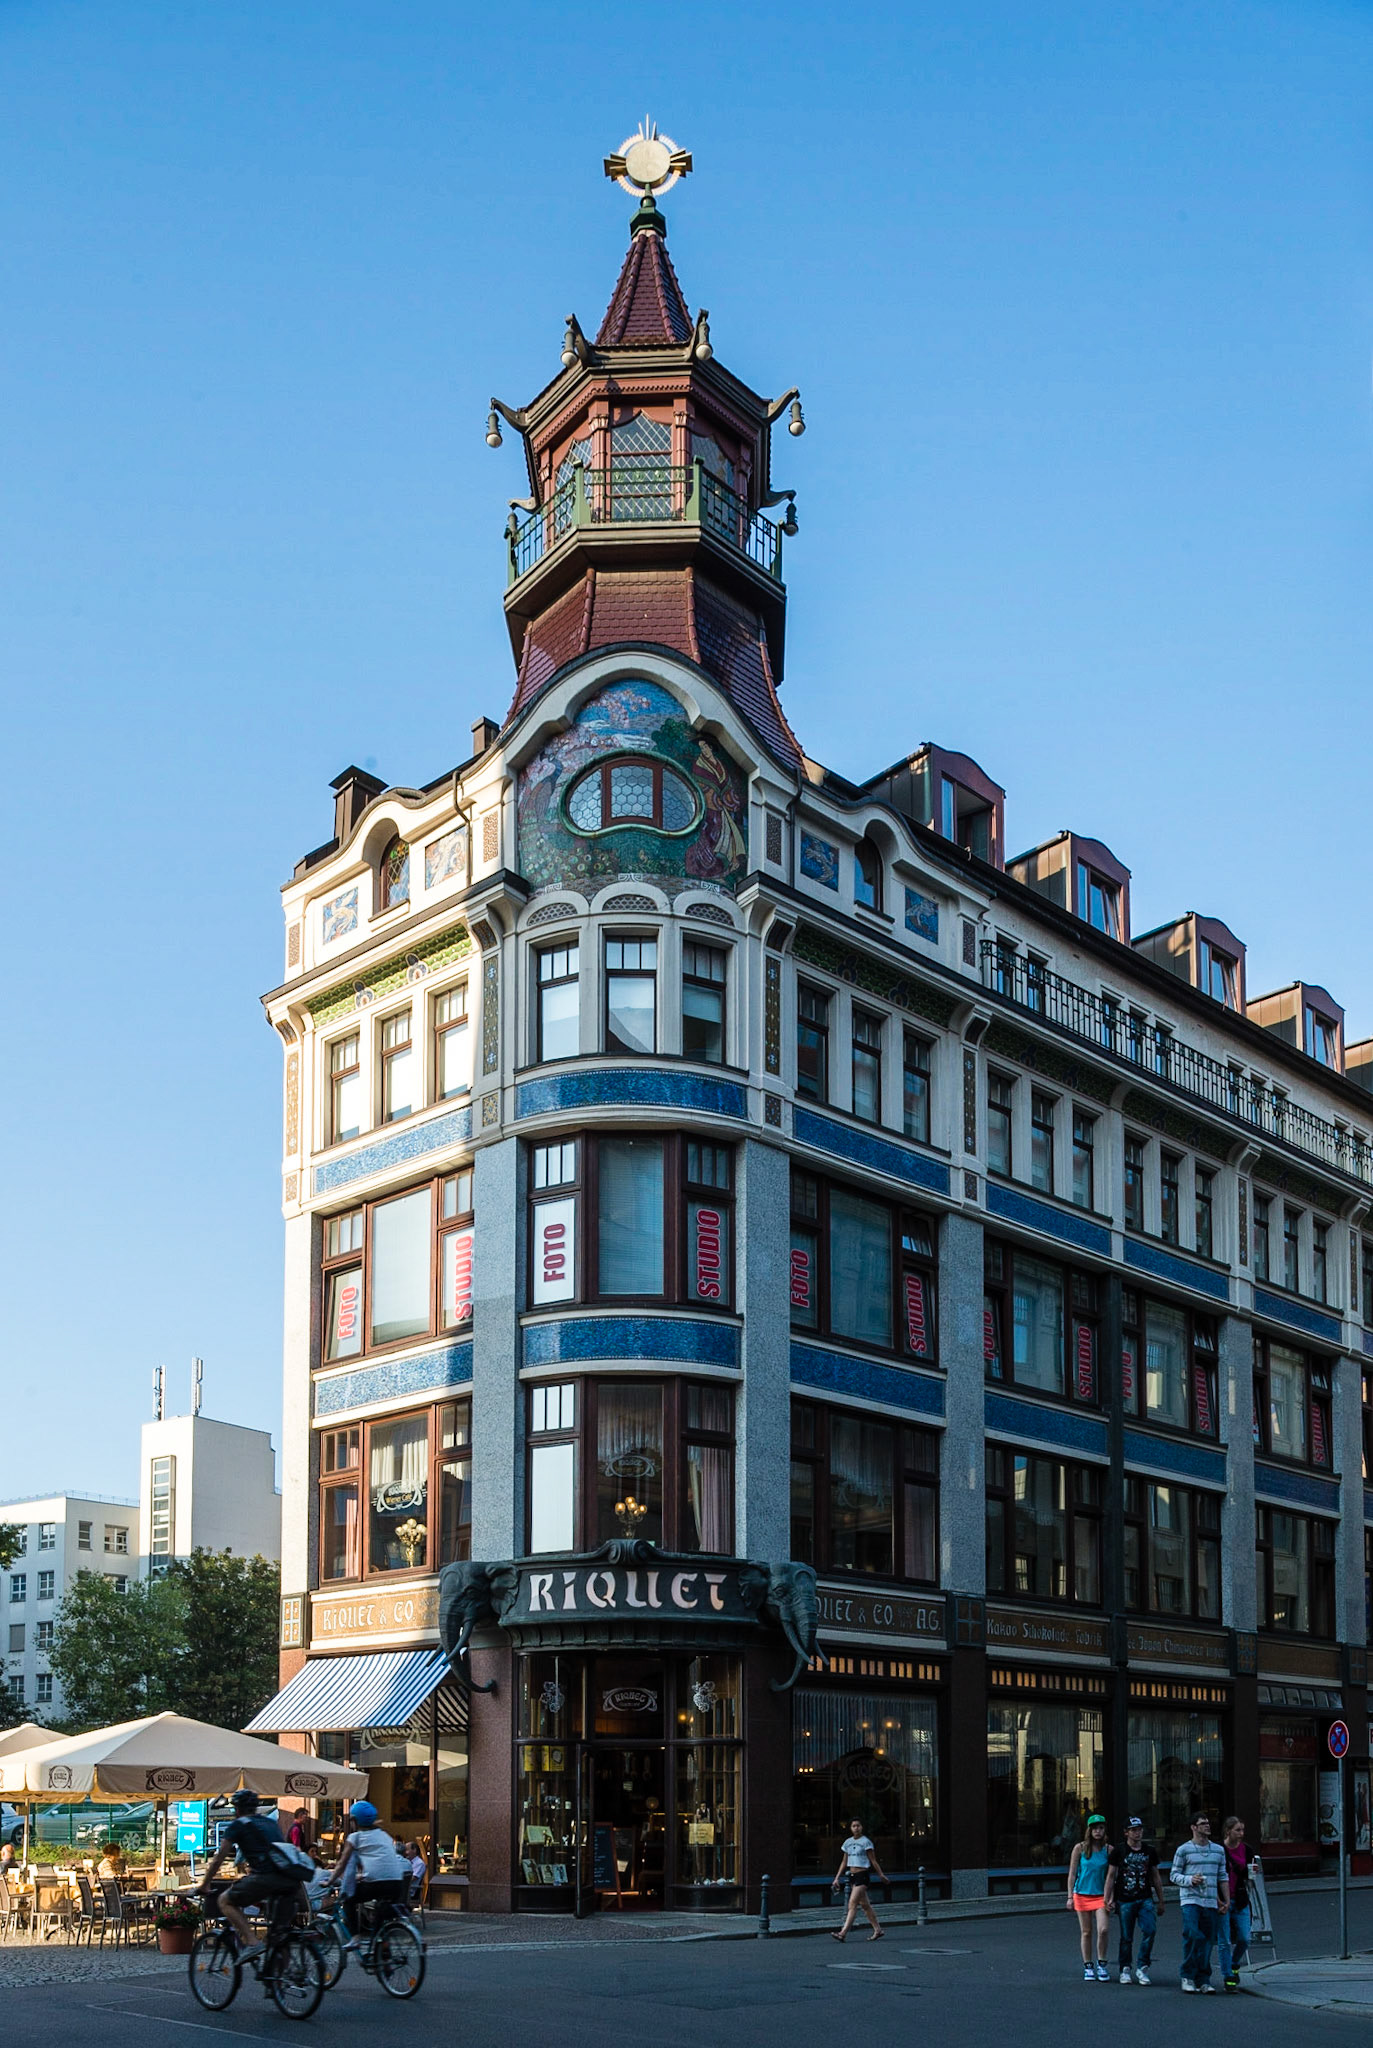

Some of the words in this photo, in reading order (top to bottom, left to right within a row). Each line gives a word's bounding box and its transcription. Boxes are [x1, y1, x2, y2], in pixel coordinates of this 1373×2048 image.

[454, 1235, 473, 1321] STUDIO
[544, 1223, 566, 1282] FOTO
[697, 1208, 721, 1299] STUDIO
[791, 1249, 809, 1308] FOTO
[337, 1286, 357, 1339] FOTO
[905, 1275, 927, 1353] STUDIO
[1078, 1326, 1093, 1398] STUDIO
[1193, 1366, 1211, 1431] STUDIO
[323, 1604, 376, 1631] RIQUET
[379, 1608, 387, 1625] &
[529, 1571, 728, 1612] RIQUET
[858, 1607, 866, 1624] &
[872, 1603, 895, 1626] CO.
[986, 1618, 1018, 1637] Kakao
